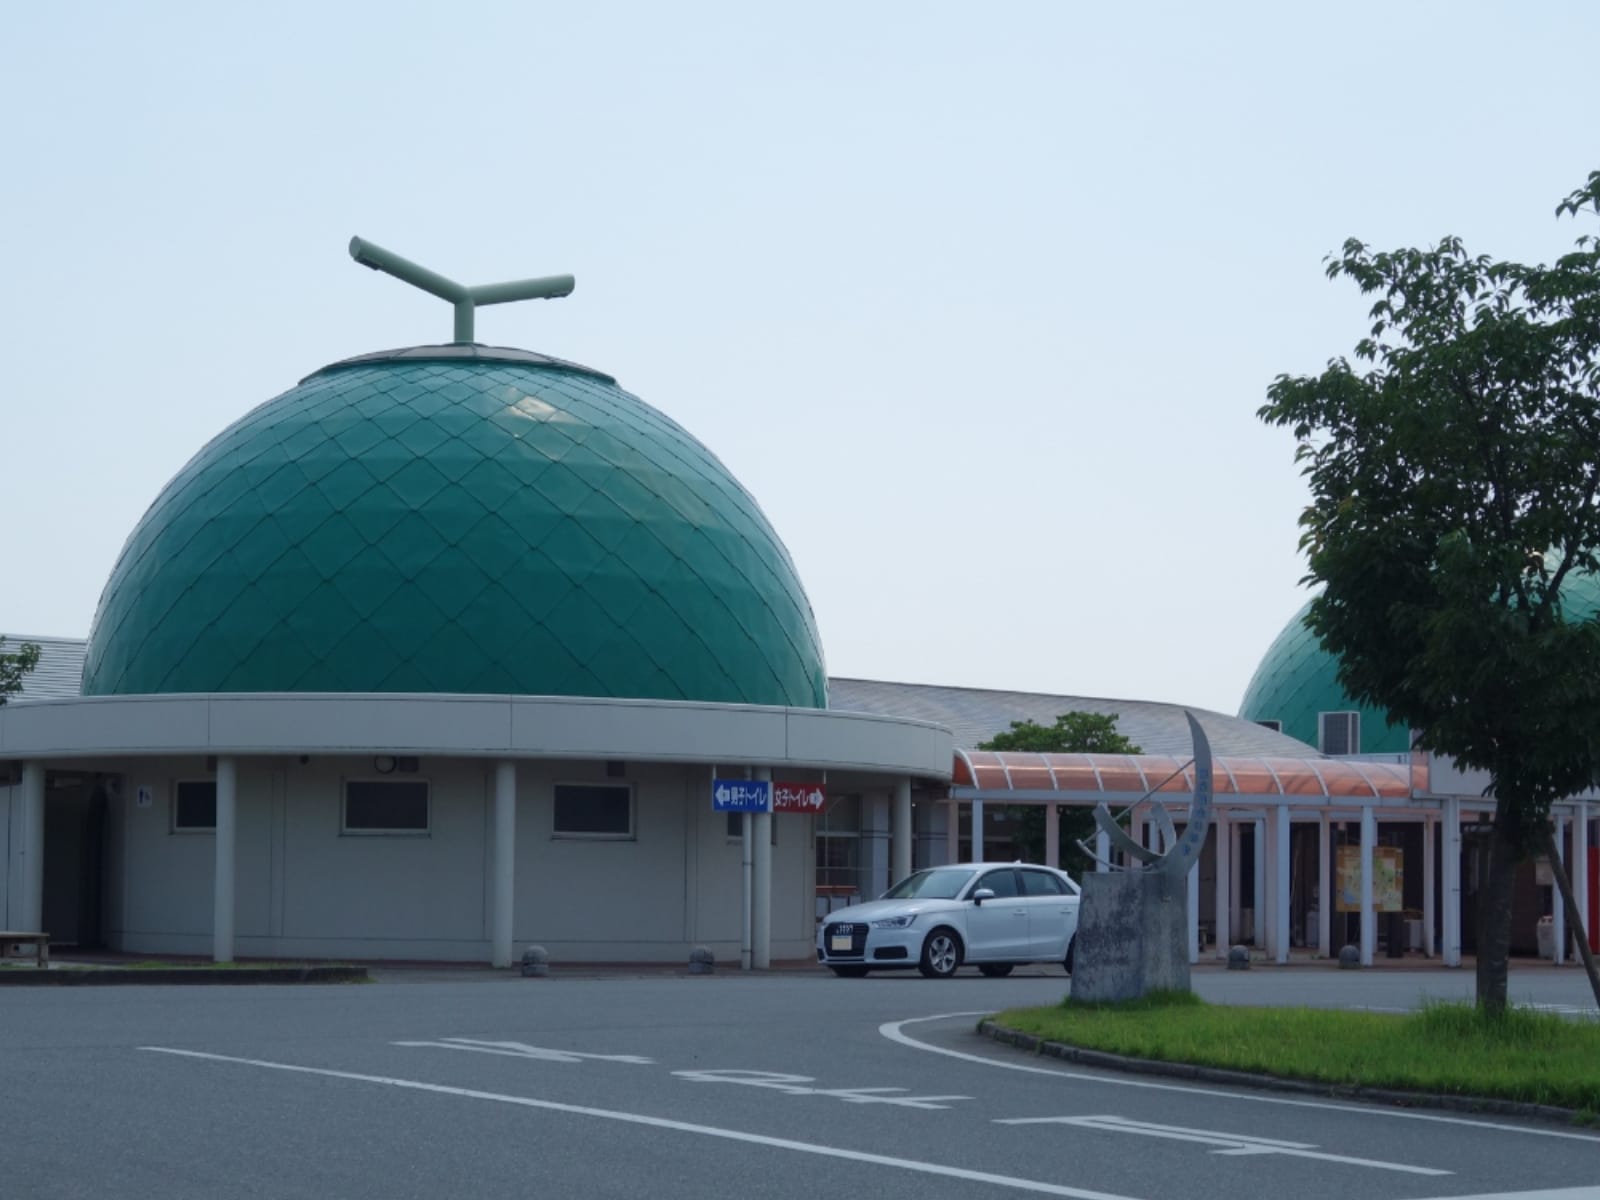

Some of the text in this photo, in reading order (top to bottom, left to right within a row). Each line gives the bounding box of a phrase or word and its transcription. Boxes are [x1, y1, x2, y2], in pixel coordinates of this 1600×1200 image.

[731, 786, 767, 806] 男子トイレ
[775, 787, 809, 807] 女子トイレ
